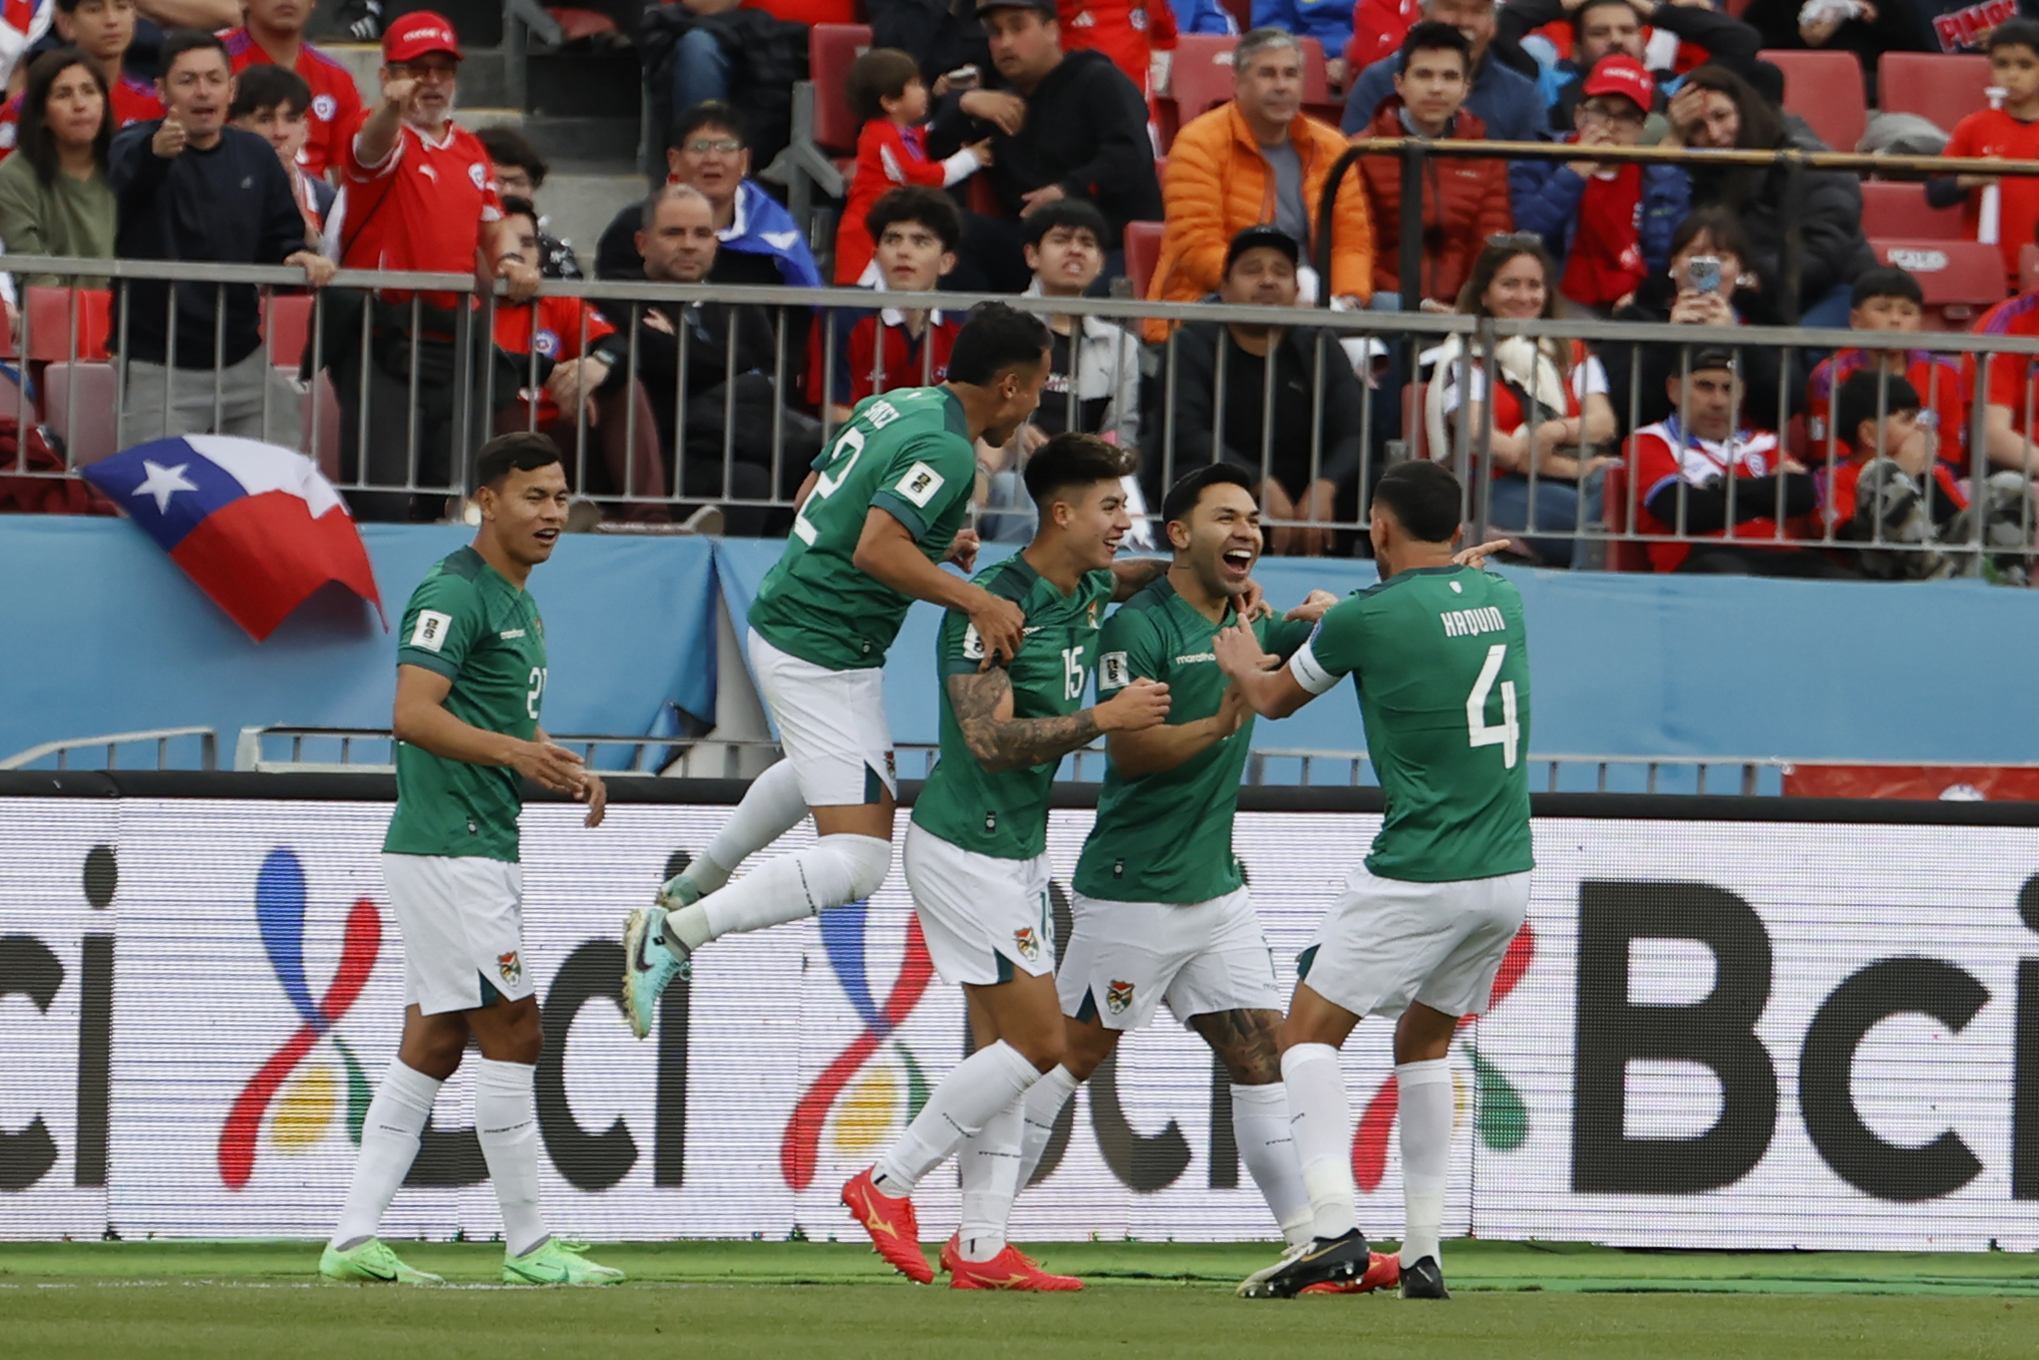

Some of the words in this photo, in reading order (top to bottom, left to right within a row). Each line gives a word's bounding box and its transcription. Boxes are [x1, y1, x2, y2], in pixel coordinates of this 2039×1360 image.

[793, 426, 865, 547] 2
[1062, 646, 1085, 701] 15
[1175, 652, 1217, 665] maratho
[1440, 606, 1506, 637] HAQUIN
[1466, 644, 1519, 769] 4
[0, 844, 118, 1191] ci
[402, 850, 693, 1192] ci
[1571, 873, 2039, 1204] Bci
